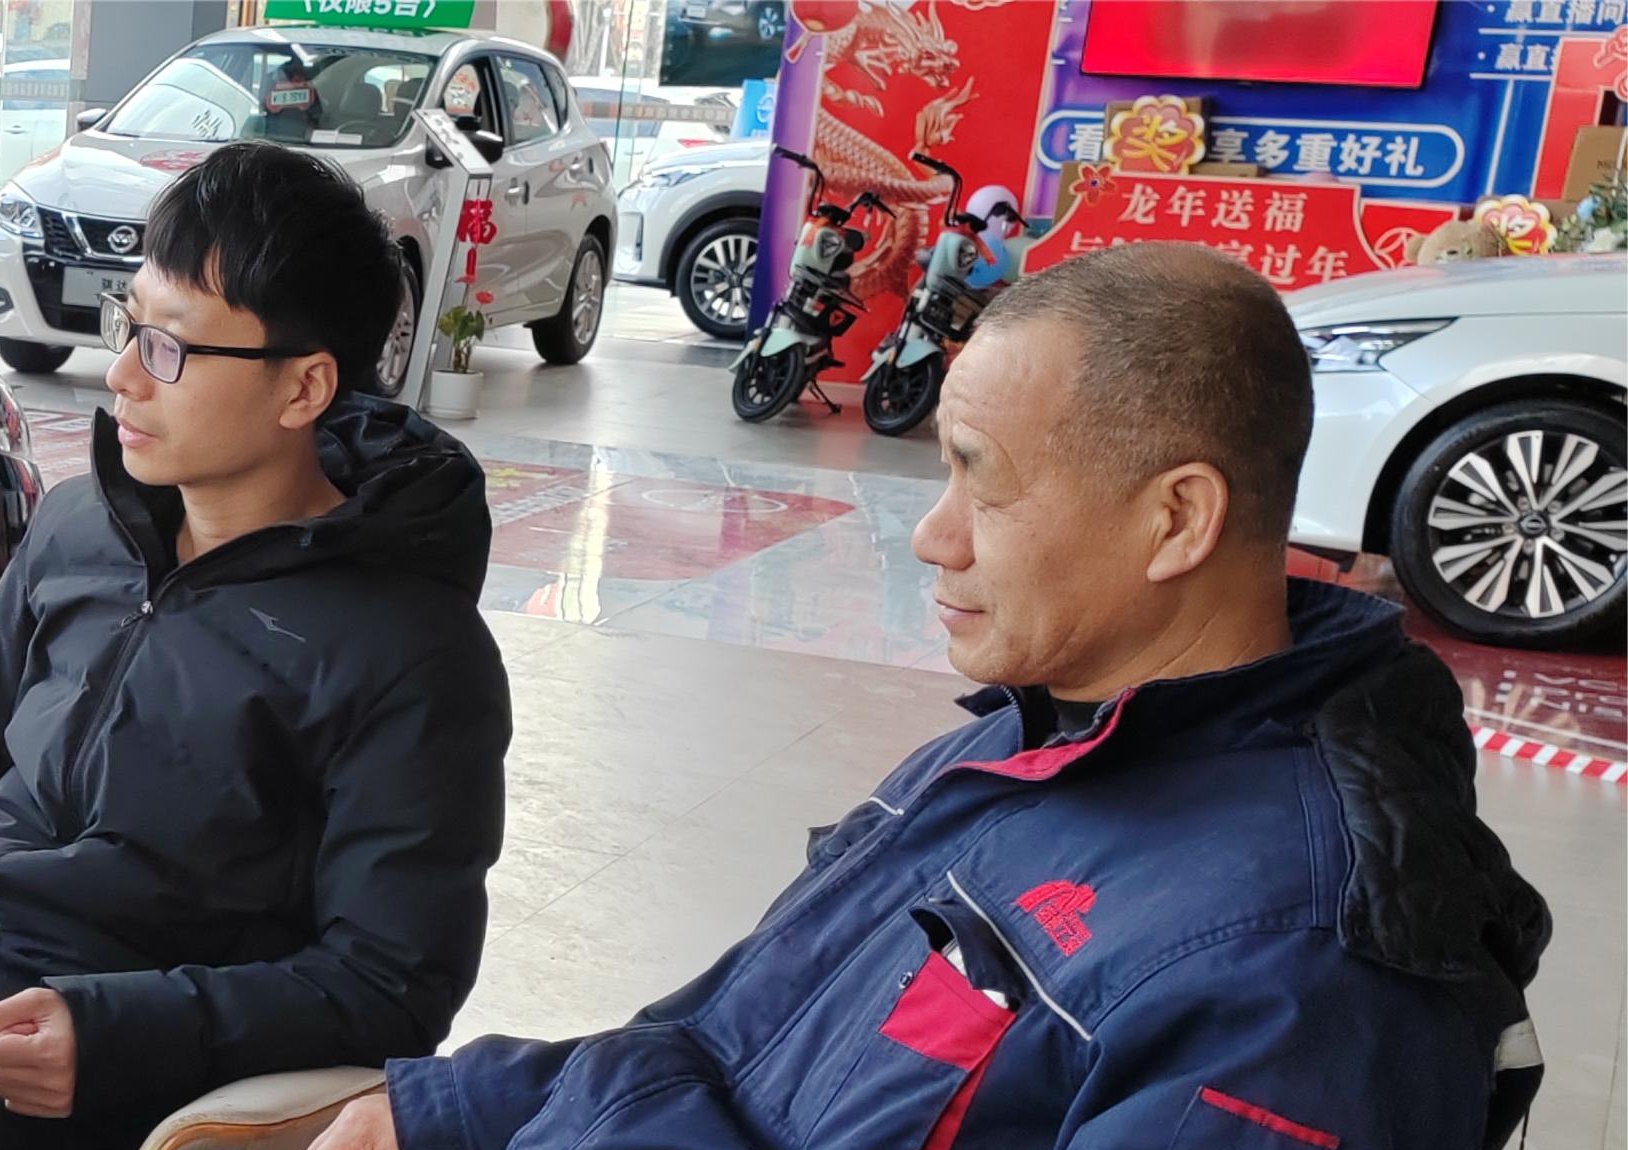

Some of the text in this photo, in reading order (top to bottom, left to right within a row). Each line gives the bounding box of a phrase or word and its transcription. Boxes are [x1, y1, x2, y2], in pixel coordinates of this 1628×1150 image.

[1504, 0, 1628, 26] 赢直播间
[1495, 43, 1556, 71] 赢直
[1069, 123, 1425, 177] 看享多重好礼
[1119, 183, 1309, 232] 龙年送福
